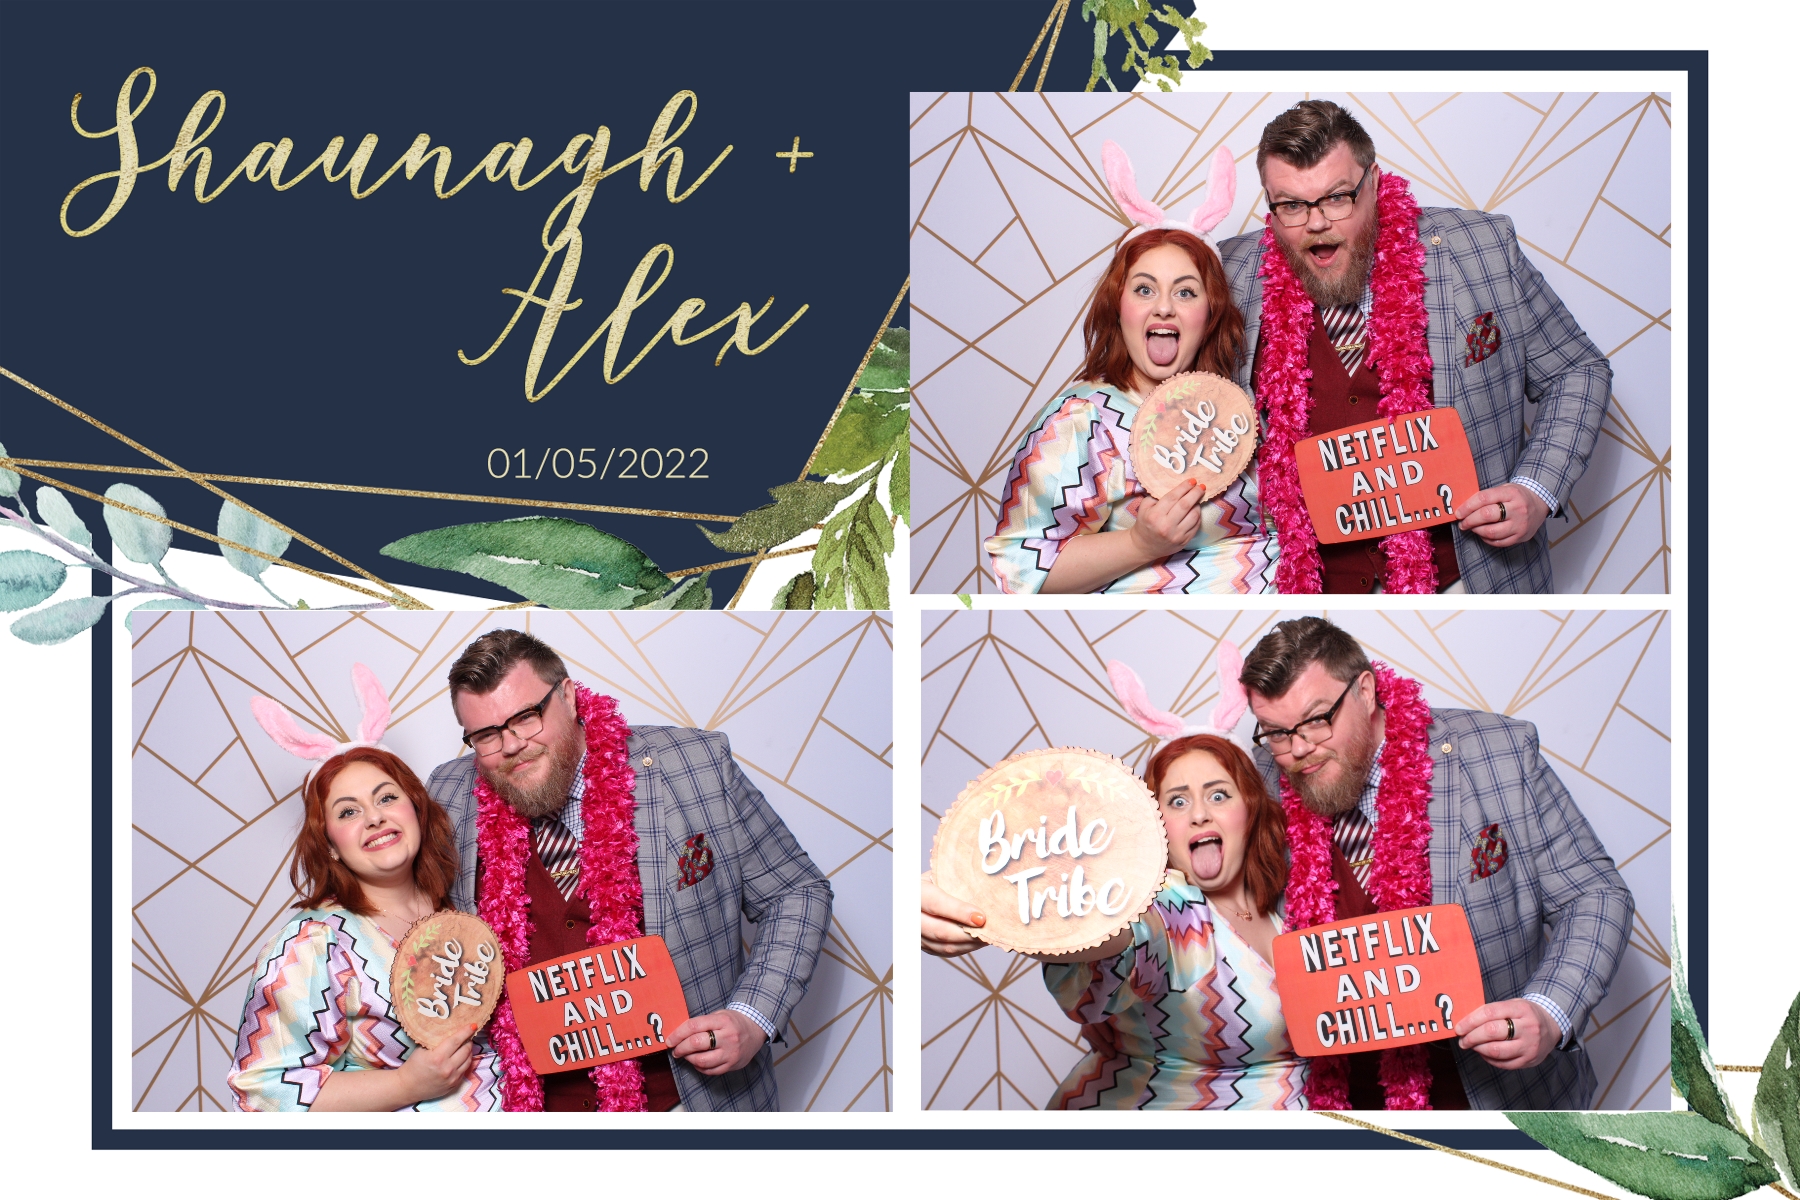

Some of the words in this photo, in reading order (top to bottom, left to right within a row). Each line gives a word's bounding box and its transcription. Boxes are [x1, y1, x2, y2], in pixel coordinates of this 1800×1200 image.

[1152, 399, 1216, 475] Bride
[1189, 412, 1250, 474] Tribe
[1317, 415, 1439, 472] NETFLIX
[1352, 460, 1424, 497] AND
[1335, 483, 1454, 536] CHILL...?
[977, 805, 1117, 875] Bride
[1003, 865, 1134, 926] Tribe
[1299, 912, 1441, 973] NETFLIX
[415, 937, 463, 1020] Bride
[452, 940, 495, 1009] Tribe
[527, 943, 647, 1003] NETFLIX
[1336, 964, 1422, 1004] AND
[564, 989, 634, 1027] AND
[1316, 993, 1454, 1048] CHILL...?
[549, 1012, 665, 1066] CHILL...?
